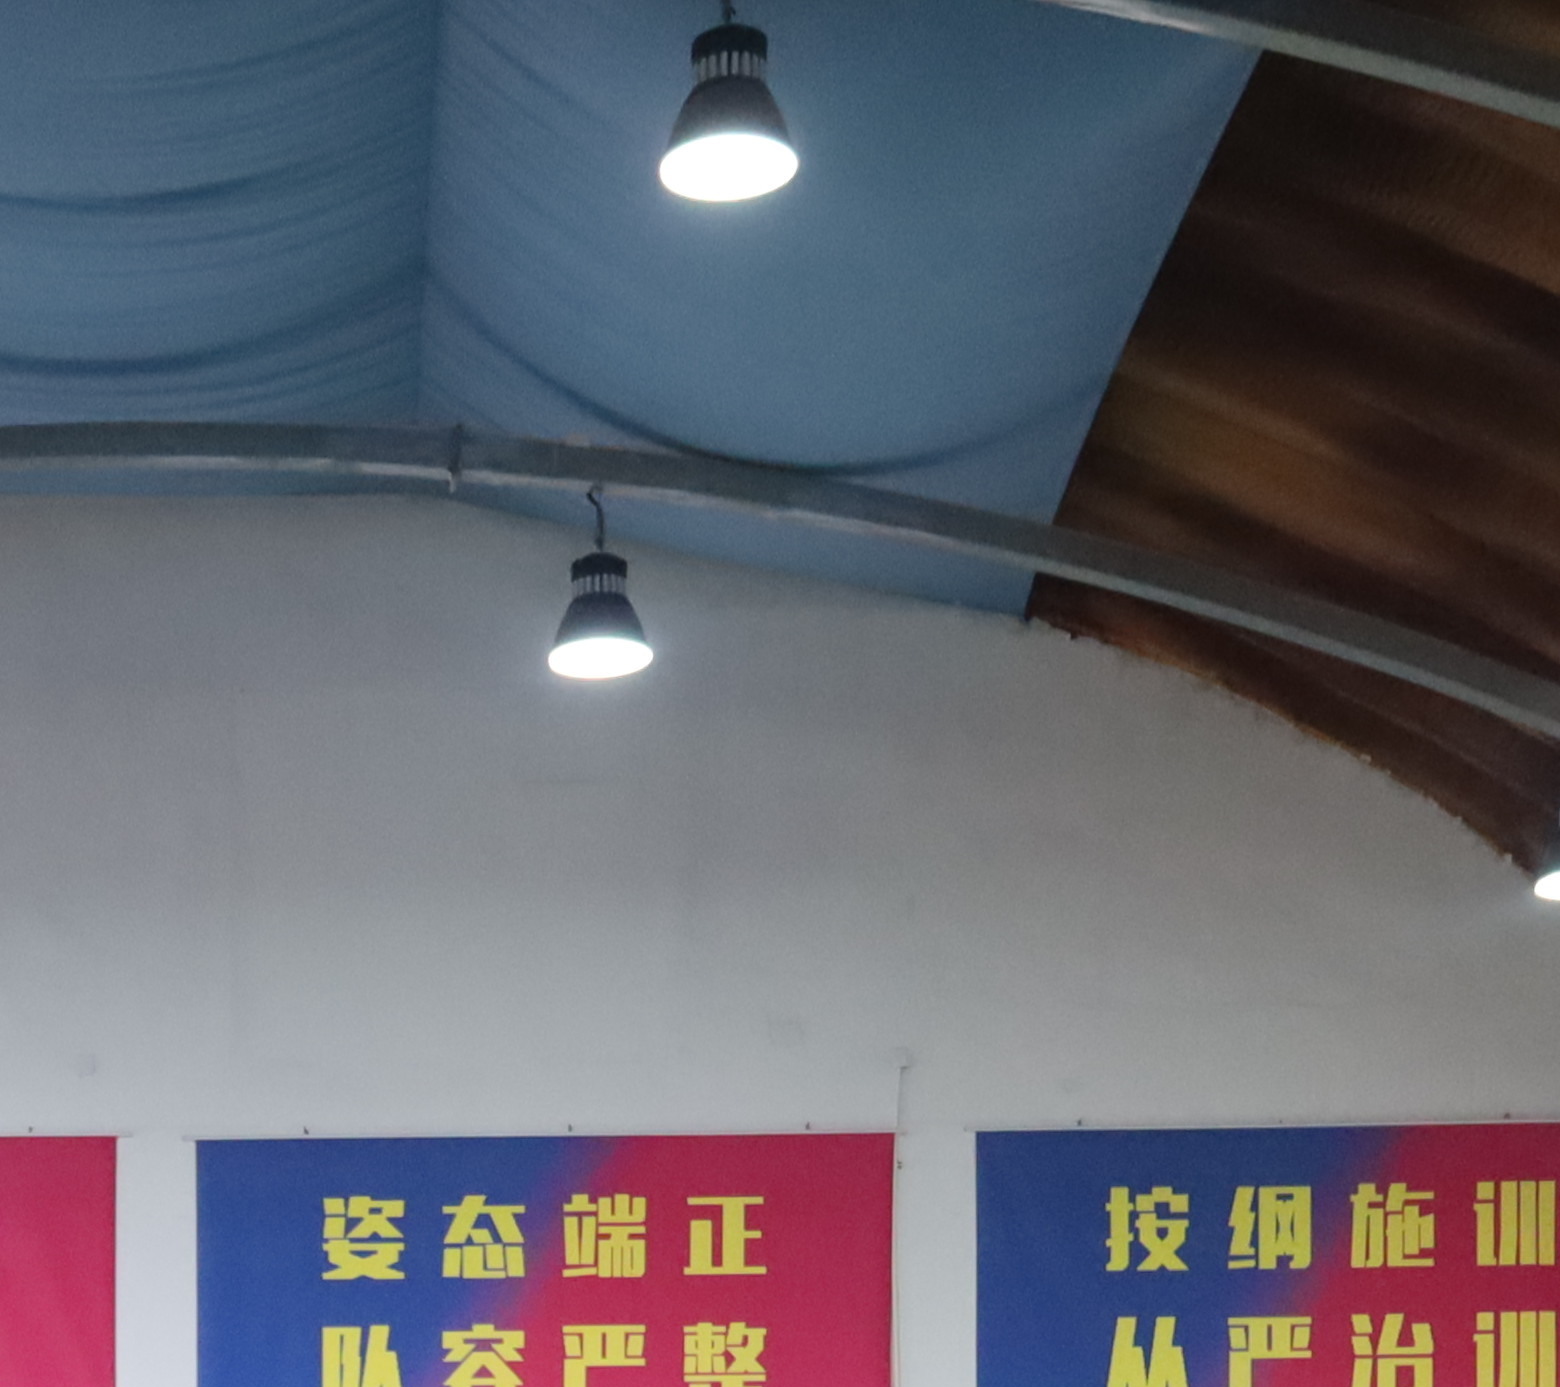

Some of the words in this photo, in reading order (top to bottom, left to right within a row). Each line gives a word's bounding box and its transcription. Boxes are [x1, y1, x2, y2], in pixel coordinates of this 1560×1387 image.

[325, 1195, 766, 1278] 姿态端正
[1108, 1182, 1554, 1270] 按纲施训
